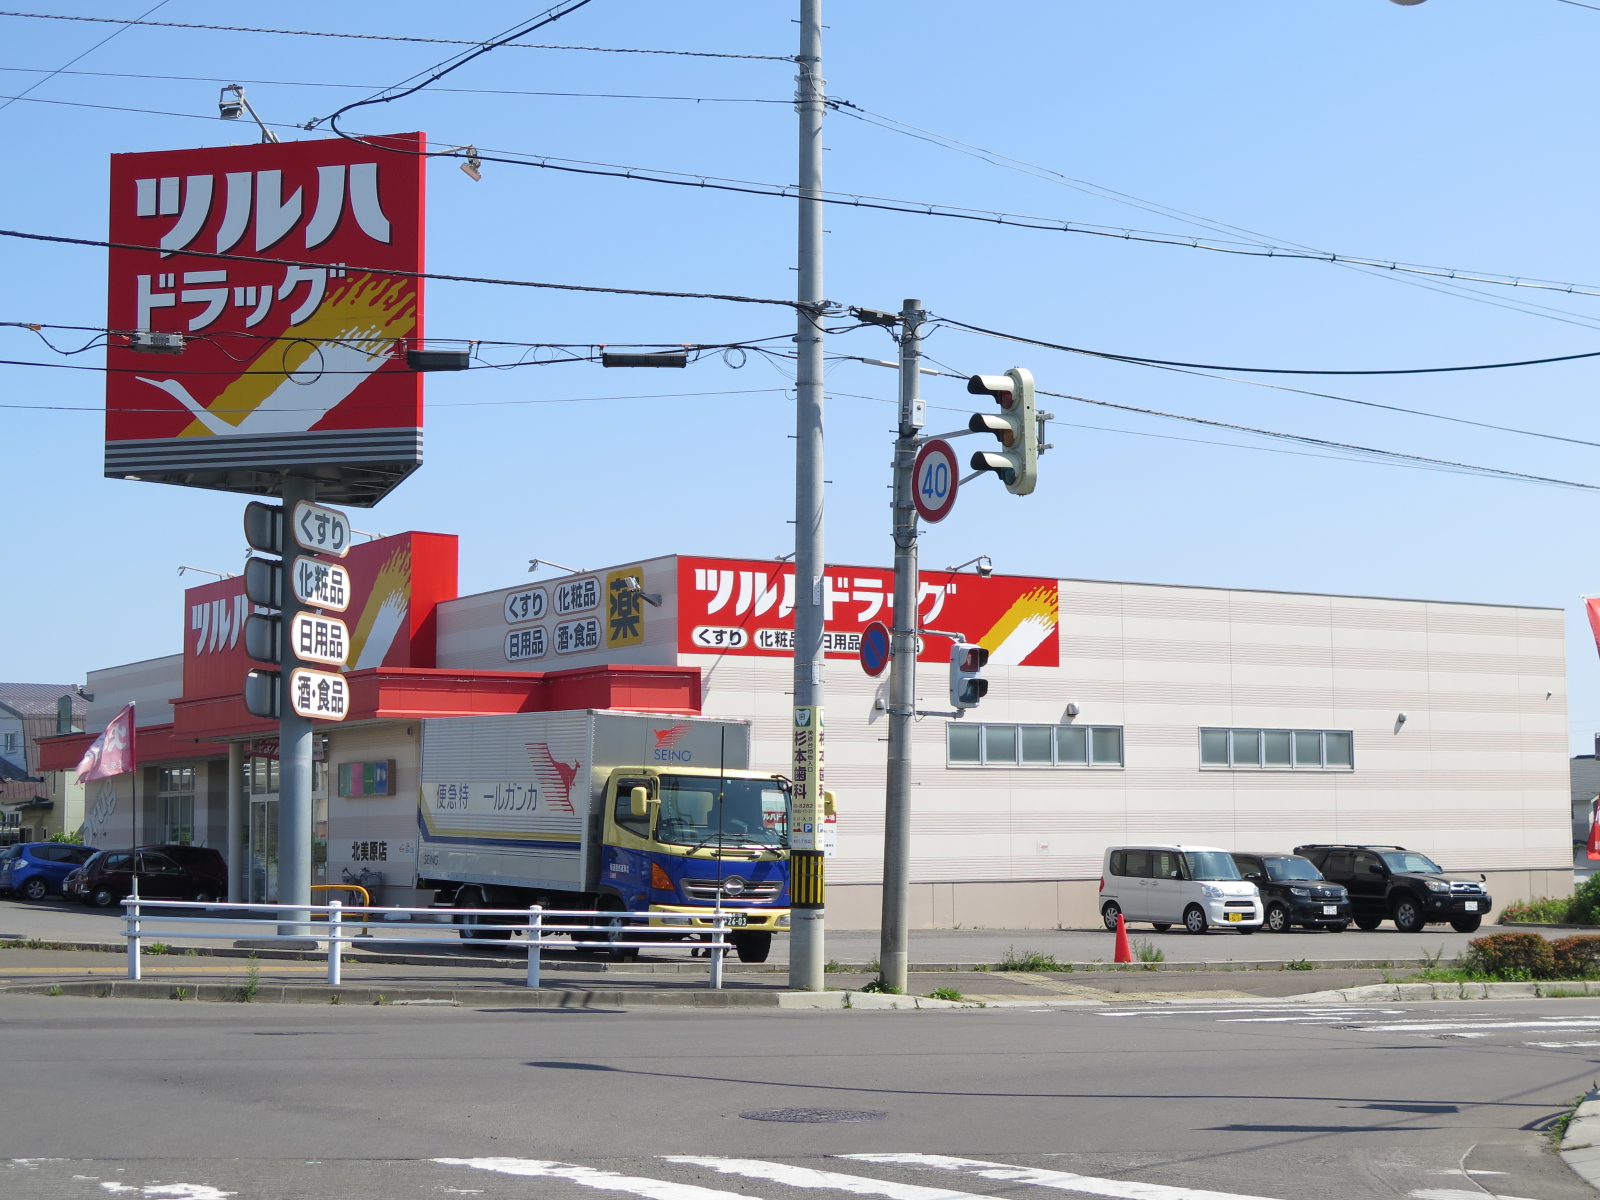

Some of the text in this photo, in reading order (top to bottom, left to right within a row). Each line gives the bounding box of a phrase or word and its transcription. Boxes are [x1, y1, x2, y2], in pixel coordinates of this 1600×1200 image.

[134, 162, 391, 259] ツルハ
[136, 262, 346, 332] ドラッグ
[922, 462, 948, 498] 40
[300, 509, 344, 550] くすり
[299, 561, 344, 606] 化粧品
[558, 580, 596, 613] 化粧品
[508, 592, 543, 619] くすり
[609, 577, 640, 641] 薬
[300, 619, 343, 660] 日用品
[509, 629, 544, 659] 日用品
[698, 628, 742, 646] くすり
[654, 749, 692, 762] SEINO
[794, 730, 807, 799] 杉本歯科
[352, 841, 387, 861] 北美原店
[727, 917, 747, 926] 26-03
